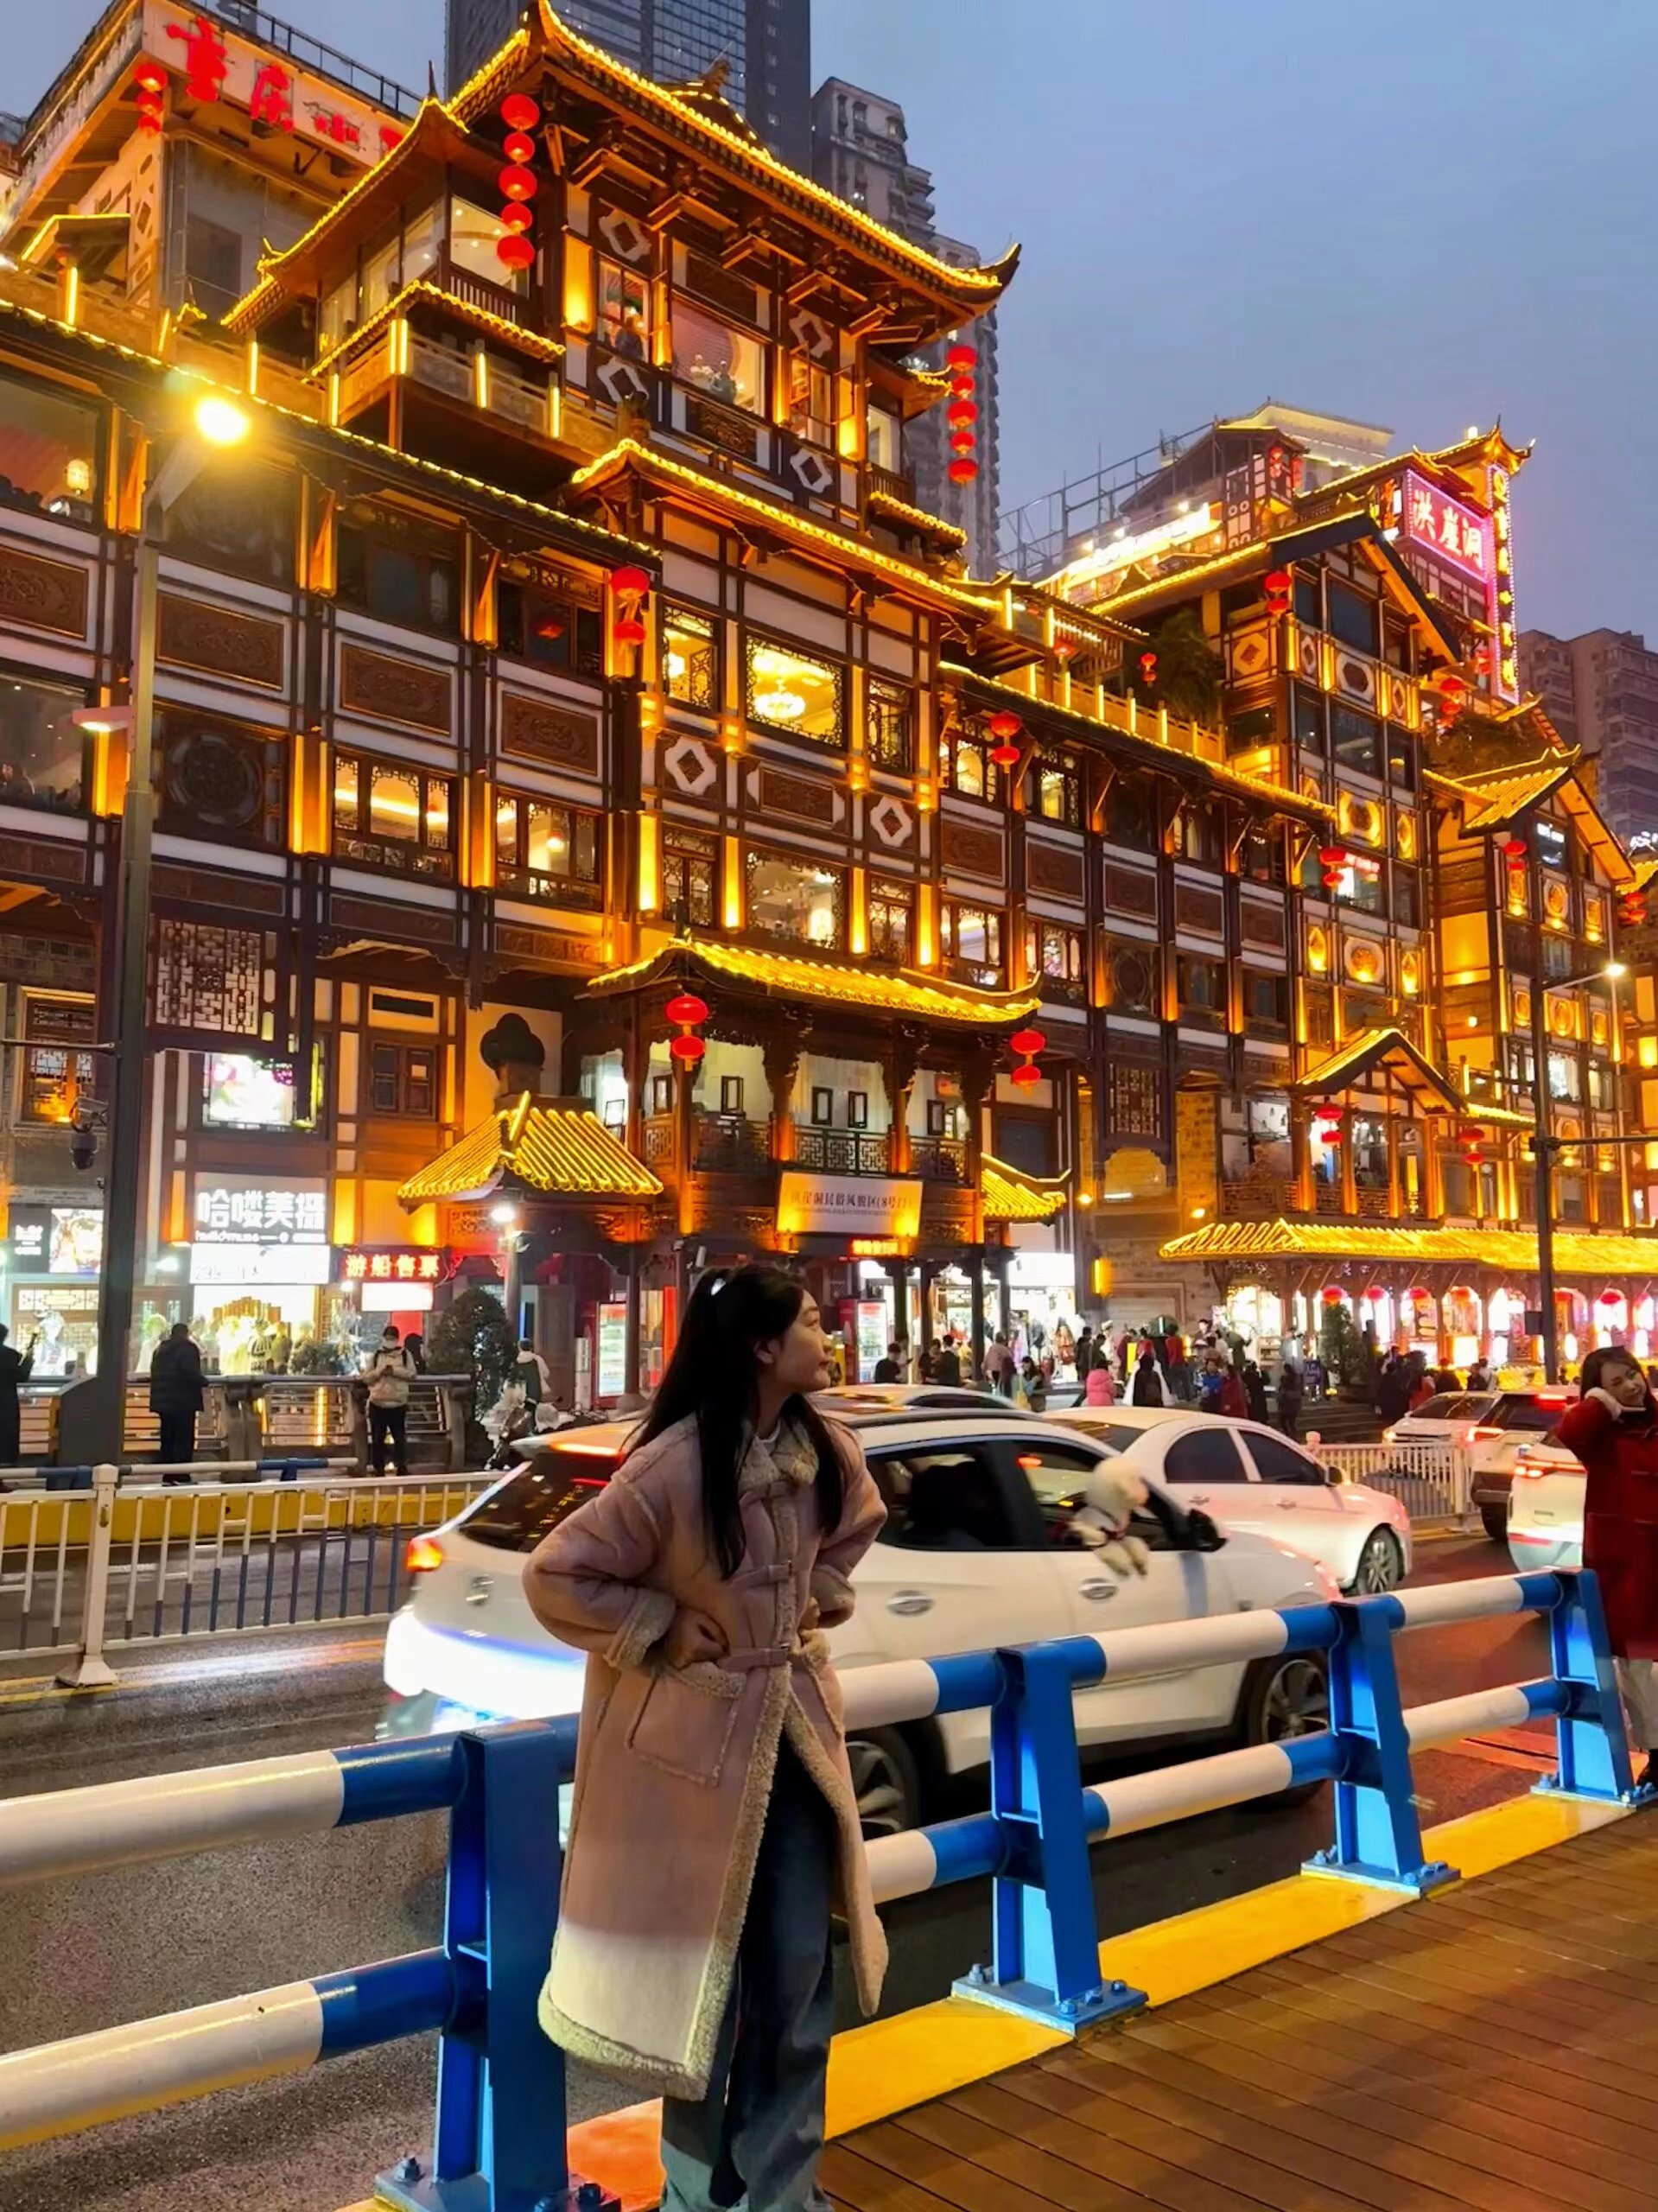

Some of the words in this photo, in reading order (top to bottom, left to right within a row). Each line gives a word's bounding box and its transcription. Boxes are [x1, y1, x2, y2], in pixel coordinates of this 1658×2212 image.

[1413, 487, 1483, 570] 洪崖洞
[346, 1253, 439, 1278] 游船售票
